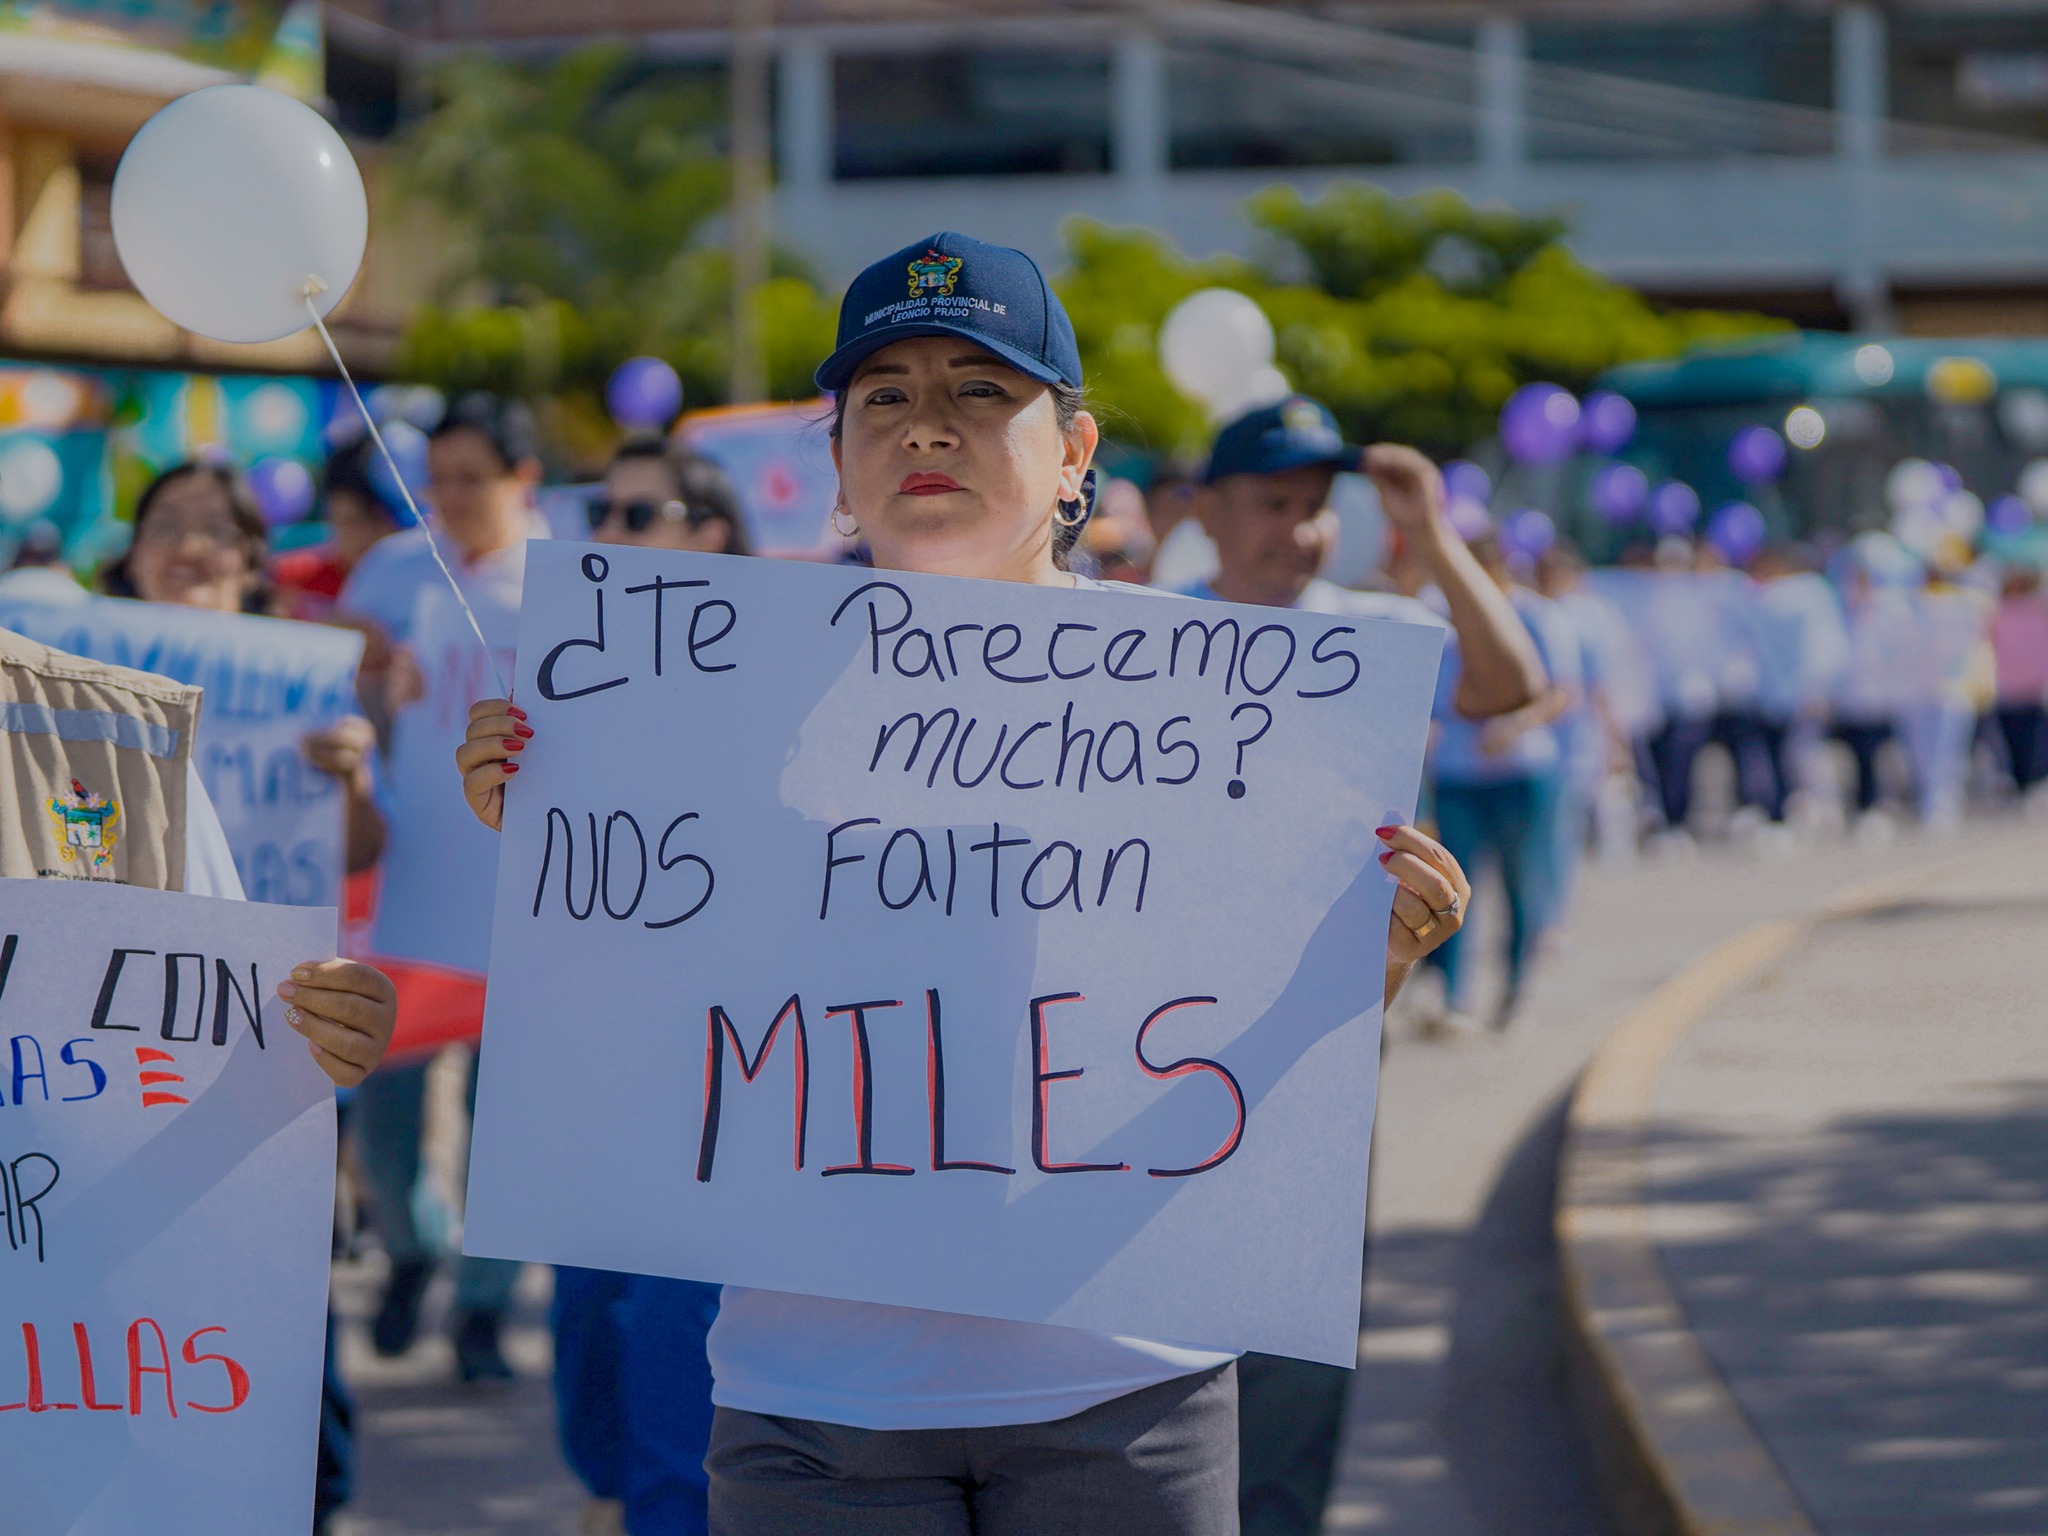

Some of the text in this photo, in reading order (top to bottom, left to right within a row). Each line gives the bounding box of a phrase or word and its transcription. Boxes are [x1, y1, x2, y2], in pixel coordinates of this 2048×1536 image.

[864, 296, 1007, 326] MUNICIPALIDAD PROVINCIAL DE
[891, 307, 969, 323] LEONCIO PRADO
[830, 580, 1361, 698] Parecemos
[533, 808, 1150, 929] NOS Faltan
[91, 949, 265, 1050] CON
[0, 1035, 107, 1106] AS
[697, 987, 1246, 1183] MILES
[0, 1317, 250, 1419] LLAS
